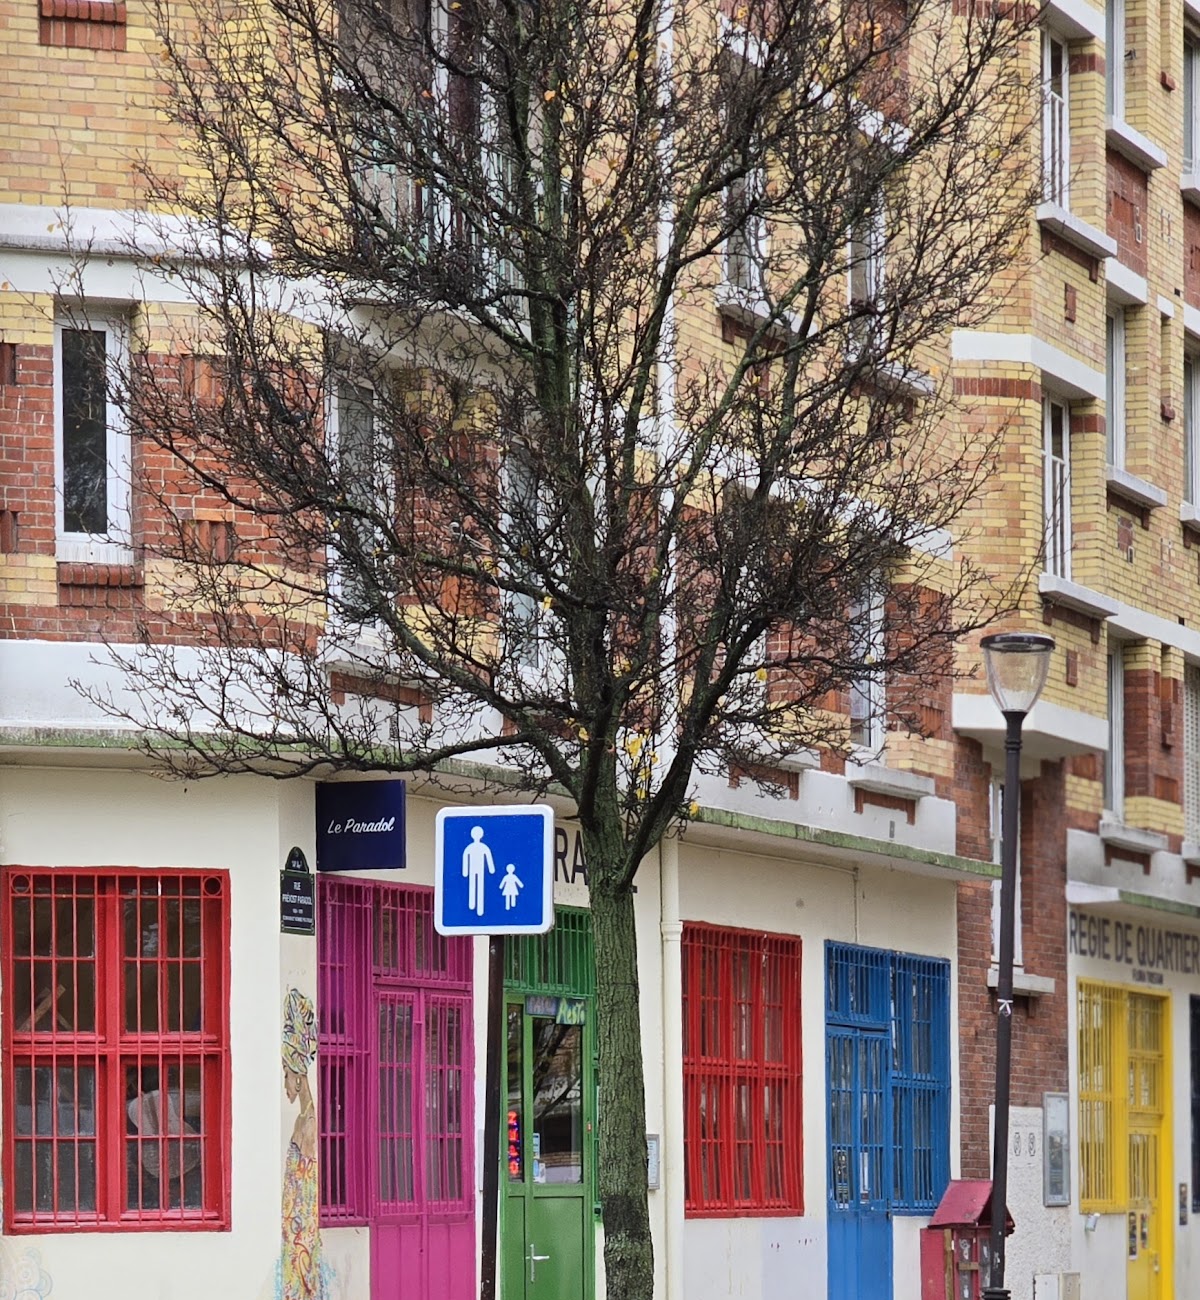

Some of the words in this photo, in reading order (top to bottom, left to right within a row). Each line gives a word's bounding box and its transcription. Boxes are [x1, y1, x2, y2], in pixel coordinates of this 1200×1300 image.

[327, 819, 342, 834] Le
[343, 816, 395, 833] Paradol
[1069, 911, 1111, 960] REGIE
[1114, 920, 1134, 965] DE
[1136, 925, 1200, 975] QUARTIER
